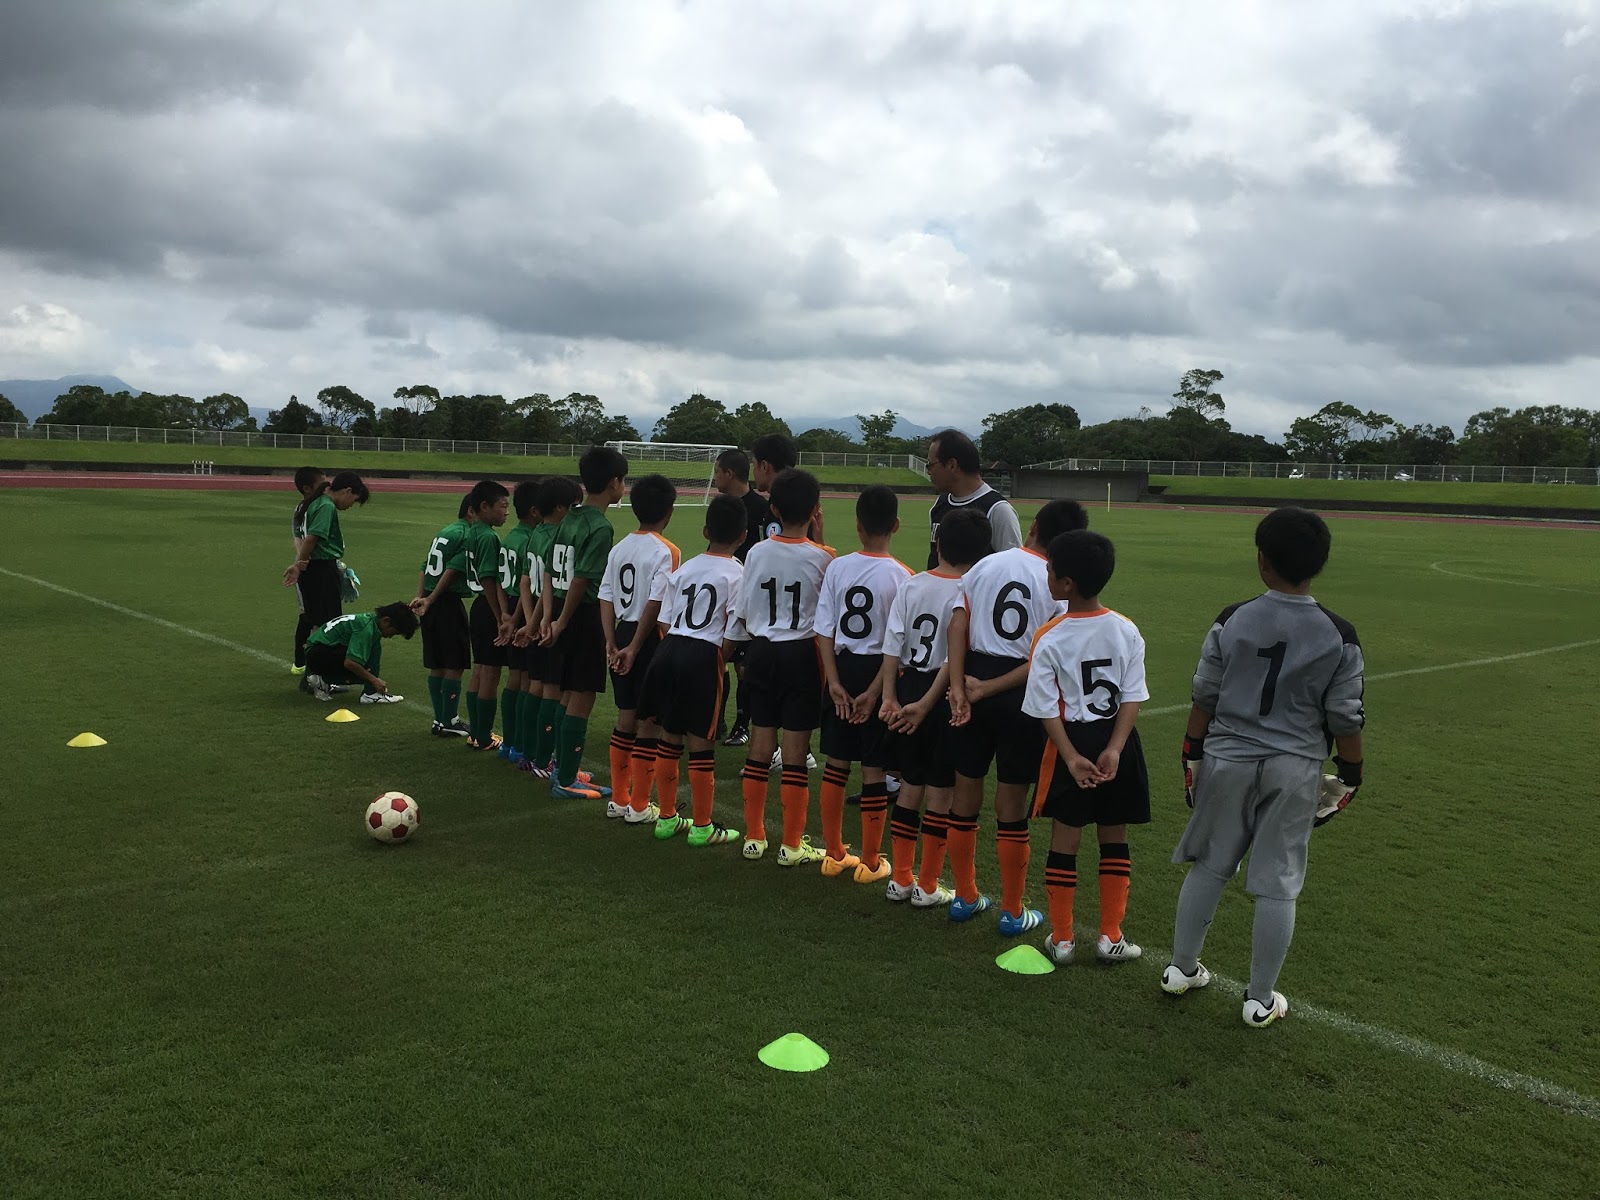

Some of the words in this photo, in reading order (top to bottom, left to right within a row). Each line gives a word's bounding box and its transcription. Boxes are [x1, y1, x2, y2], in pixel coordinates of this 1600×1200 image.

[619, 563, 636, 609] 9
[674, 583, 717, 630] 10
[761, 577, 801, 630] 11
[840, 585, 874, 639] 8
[993, 581, 1031, 641] 6
[909, 613, 939, 668] 3
[1081, 658, 1120, 717] 5
[1257, 641, 1287, 716] 1
